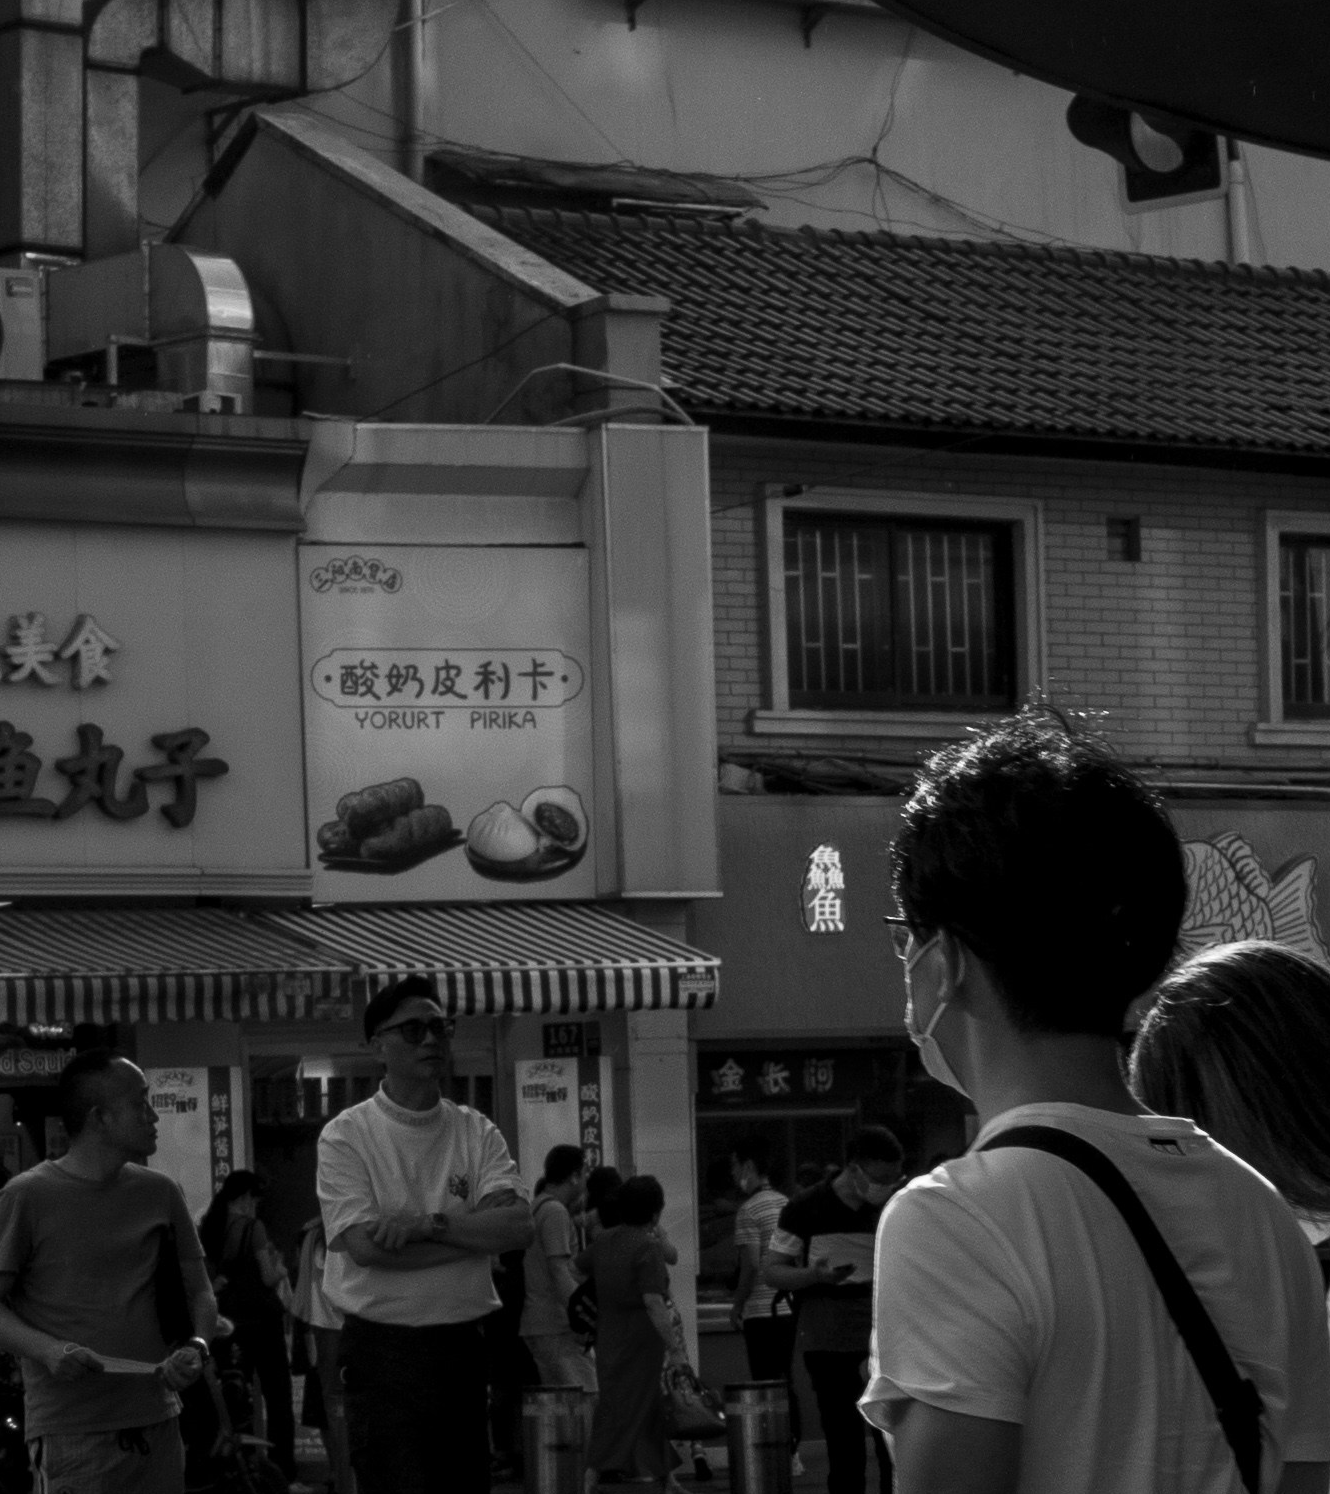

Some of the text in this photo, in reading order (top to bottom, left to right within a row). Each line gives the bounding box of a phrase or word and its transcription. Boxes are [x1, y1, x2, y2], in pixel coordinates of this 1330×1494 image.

[338, 657, 557, 703] 酸奶皮利卡
[353, 710, 538, 730] YORURT PIRIKA
[580, 1081, 601, 1176] 酸奶皮利
